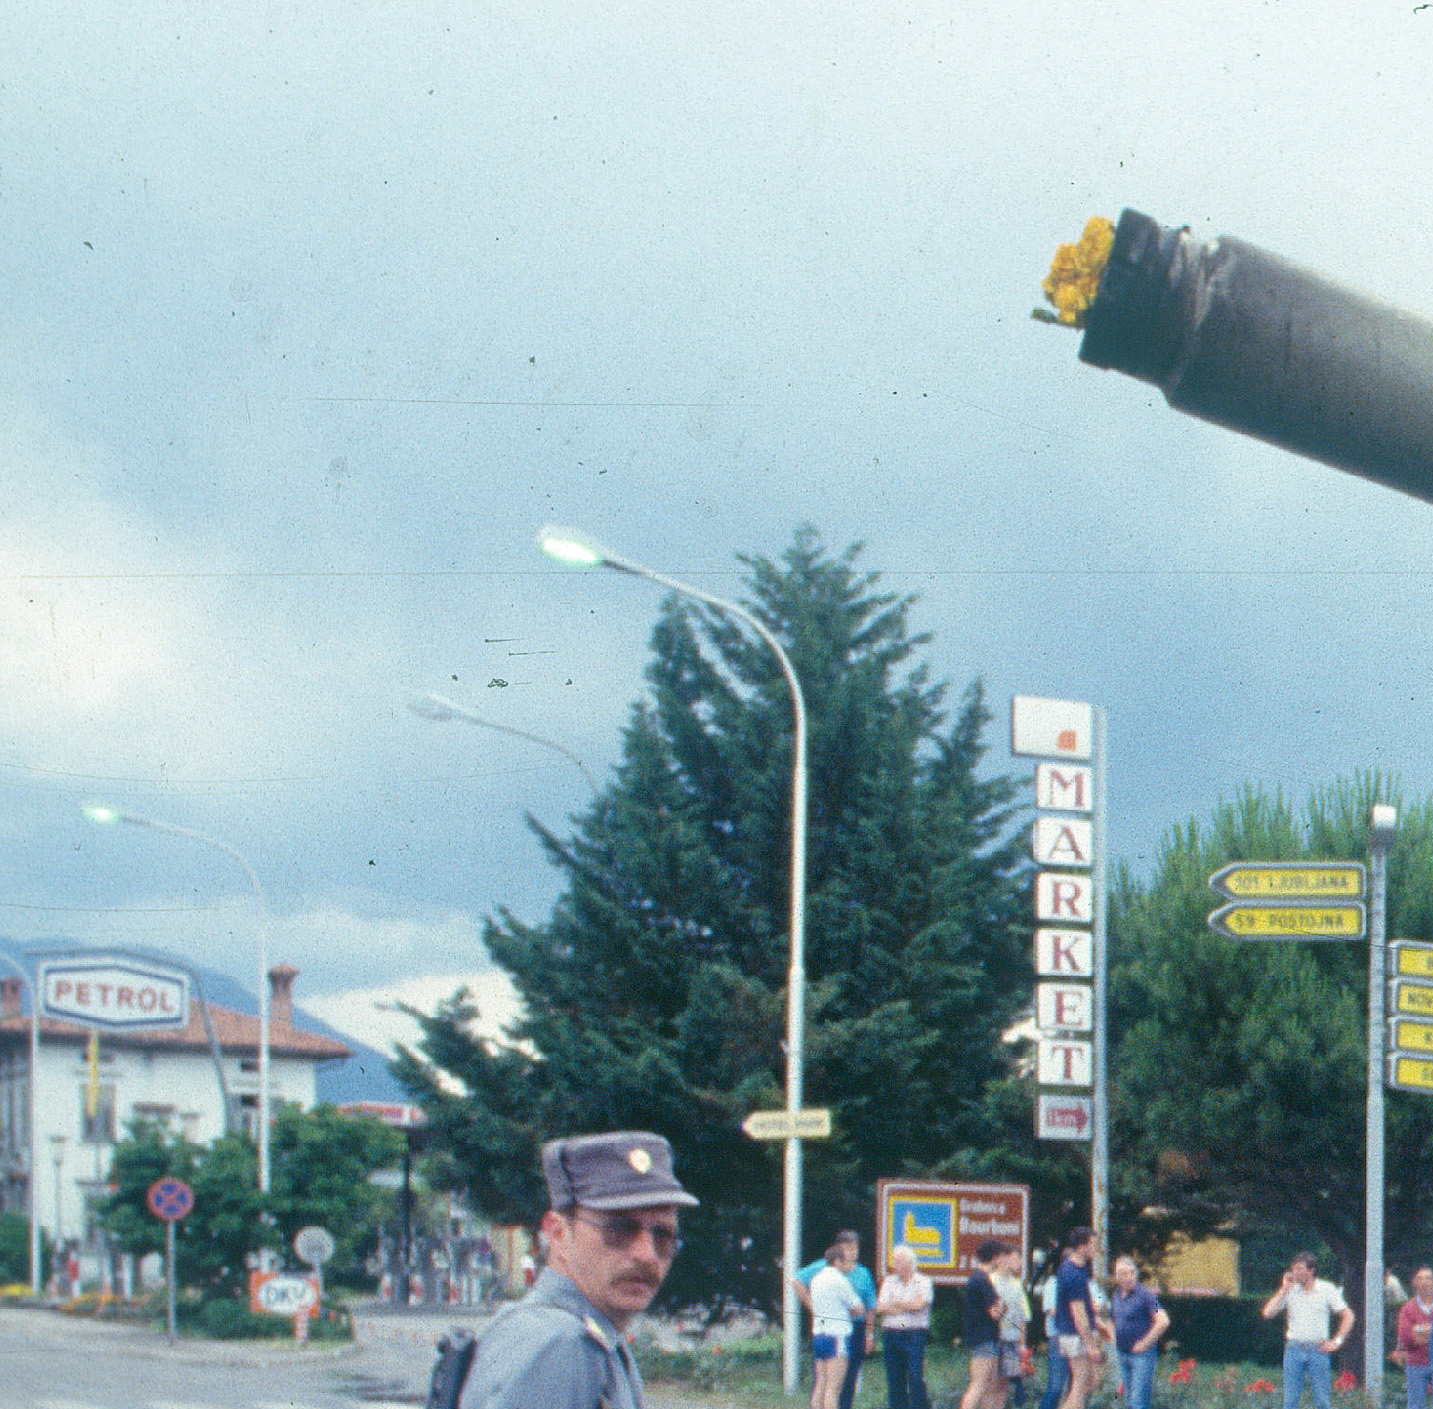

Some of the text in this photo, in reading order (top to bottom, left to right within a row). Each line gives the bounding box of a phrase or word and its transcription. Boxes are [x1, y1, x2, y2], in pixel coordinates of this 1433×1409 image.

[1268, 875, 1348, 889] LJUBLJANA
[1046, 770, 1088, 1082] MARKET
[1268, 913, 1344, 929] POSTOJNA
[54, 980, 176, 1014] PETROL
